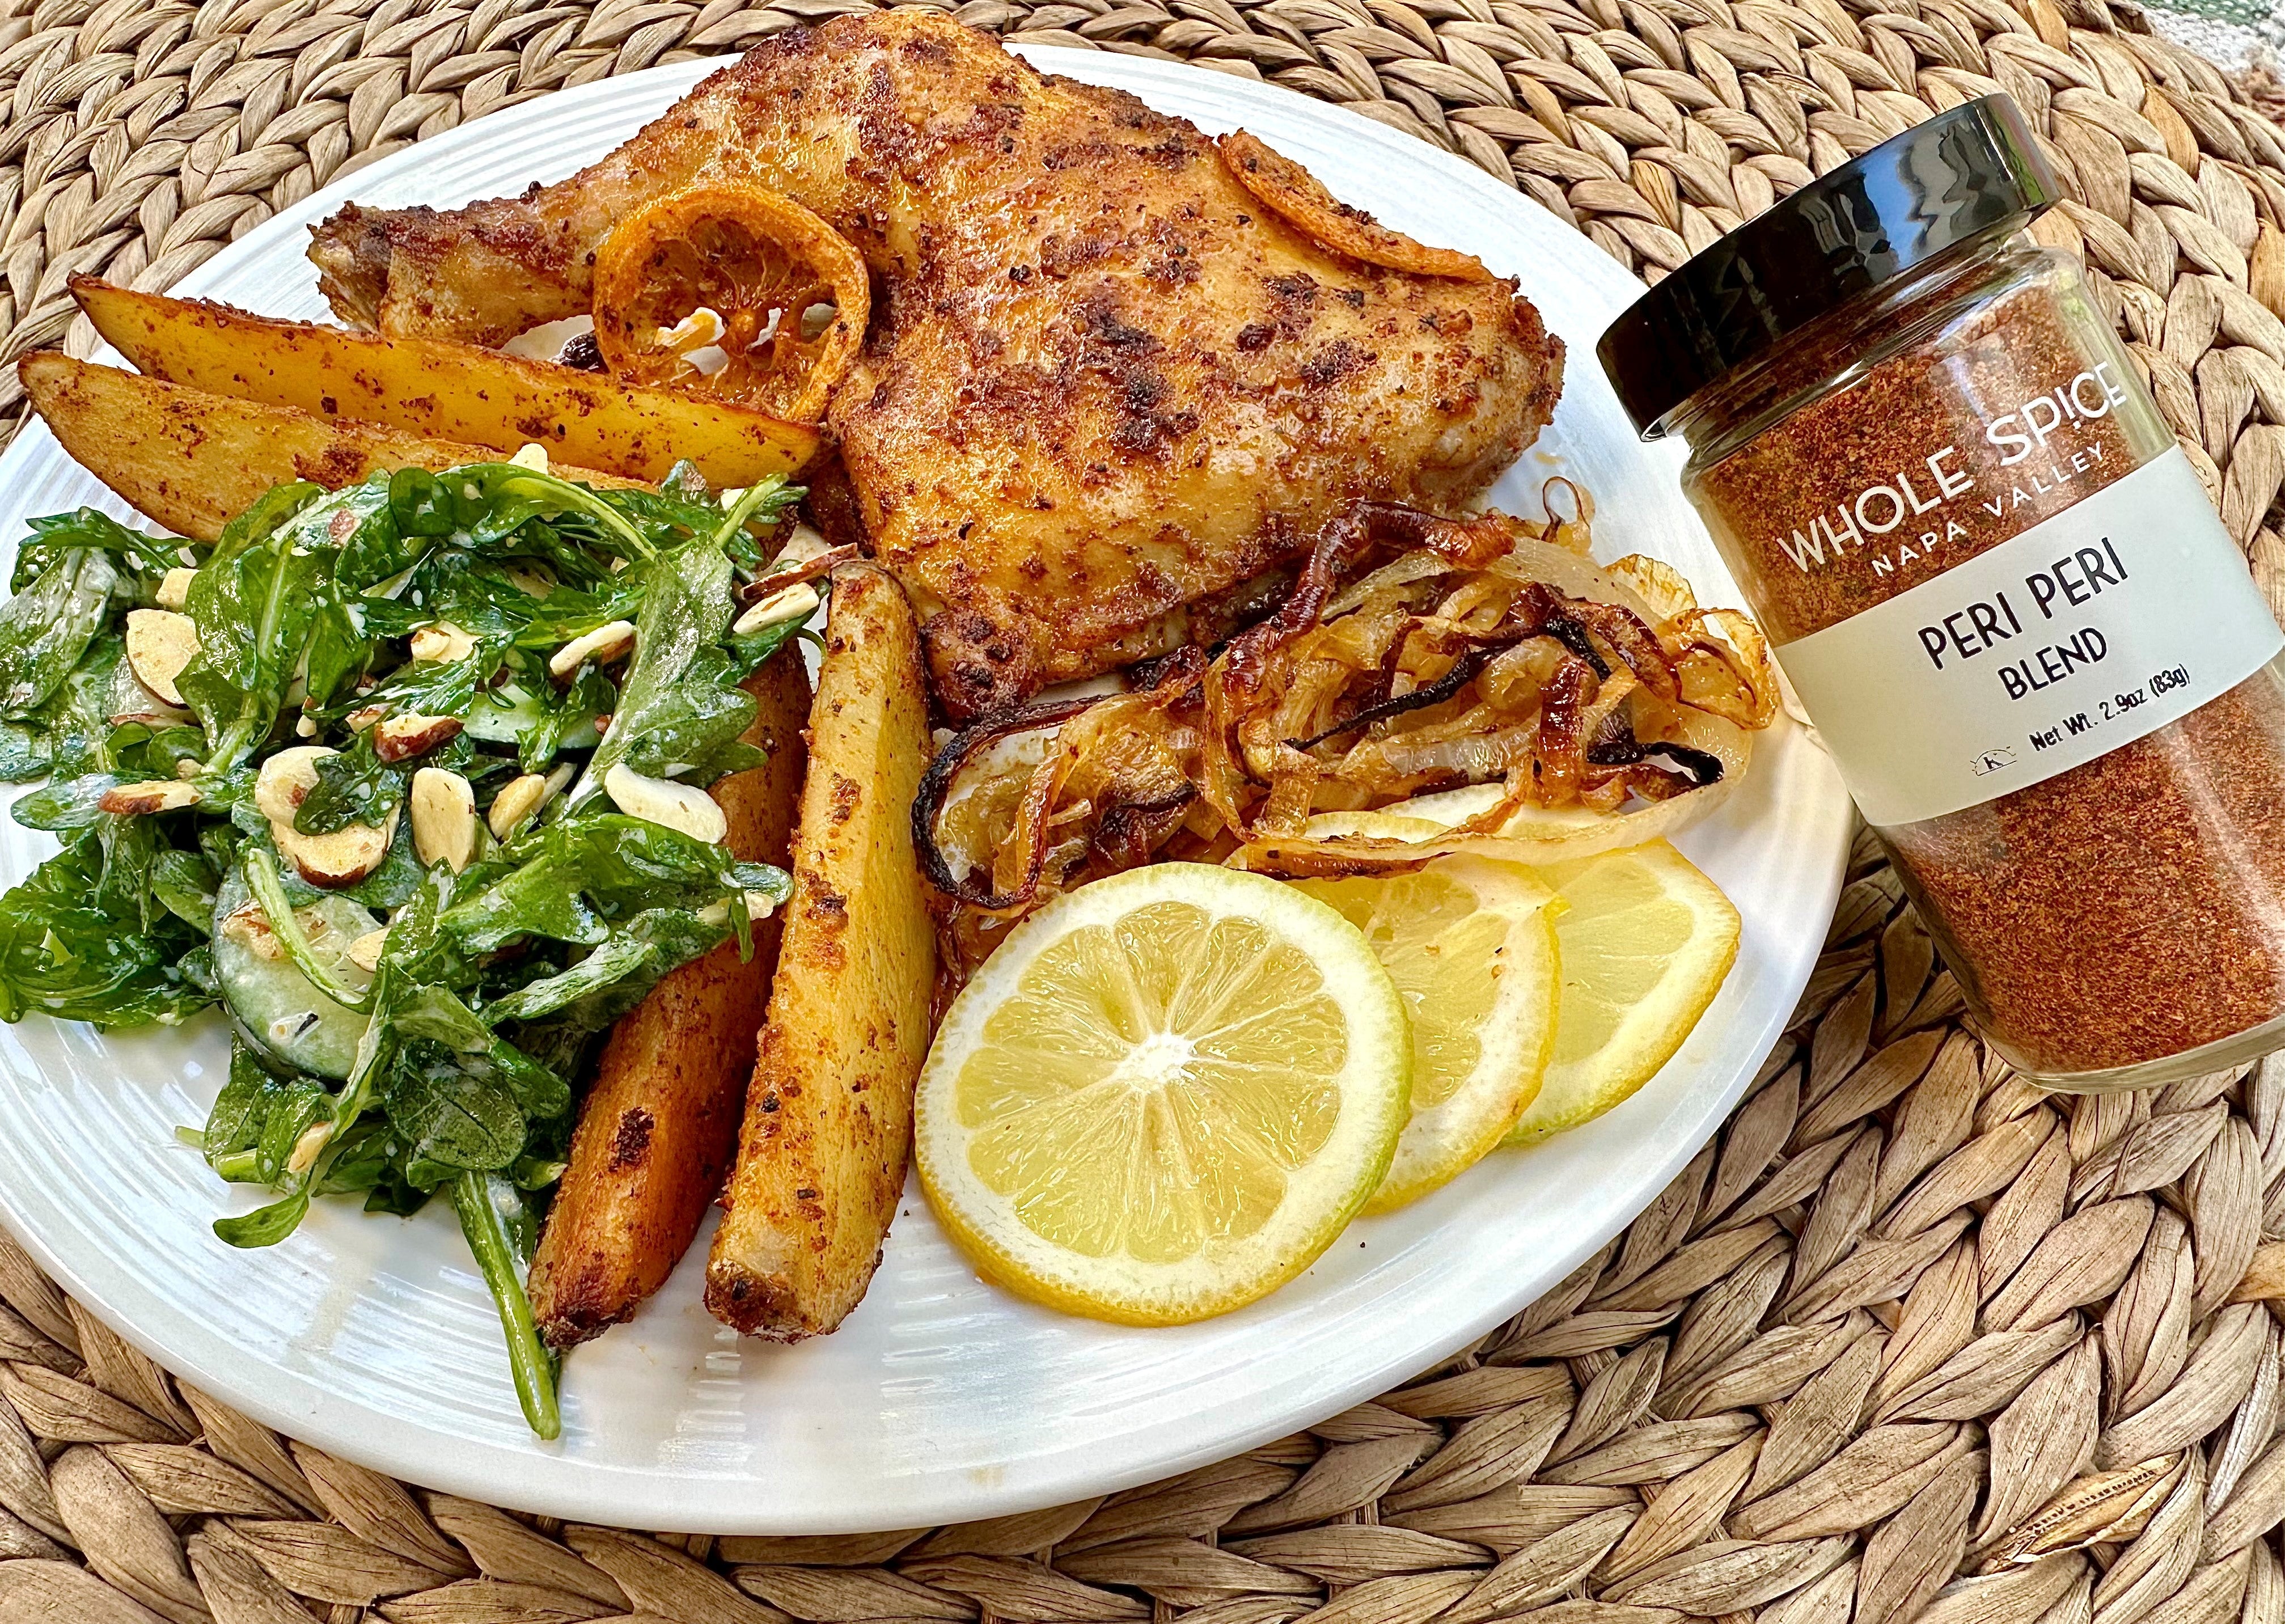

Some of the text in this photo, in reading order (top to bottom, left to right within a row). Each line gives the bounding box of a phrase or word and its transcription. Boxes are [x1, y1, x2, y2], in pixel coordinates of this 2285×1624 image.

[1776, 361, 2127, 573] WHOLE SPICE
[1871, 441, 2104, 577] NAPA VALLEY
[1918, 537, 2128, 670] PERI PERI
[1998, 627, 2108, 700] BLEND
[2029, 663, 2191, 752] Net Wt. 2.9oz (83g)
